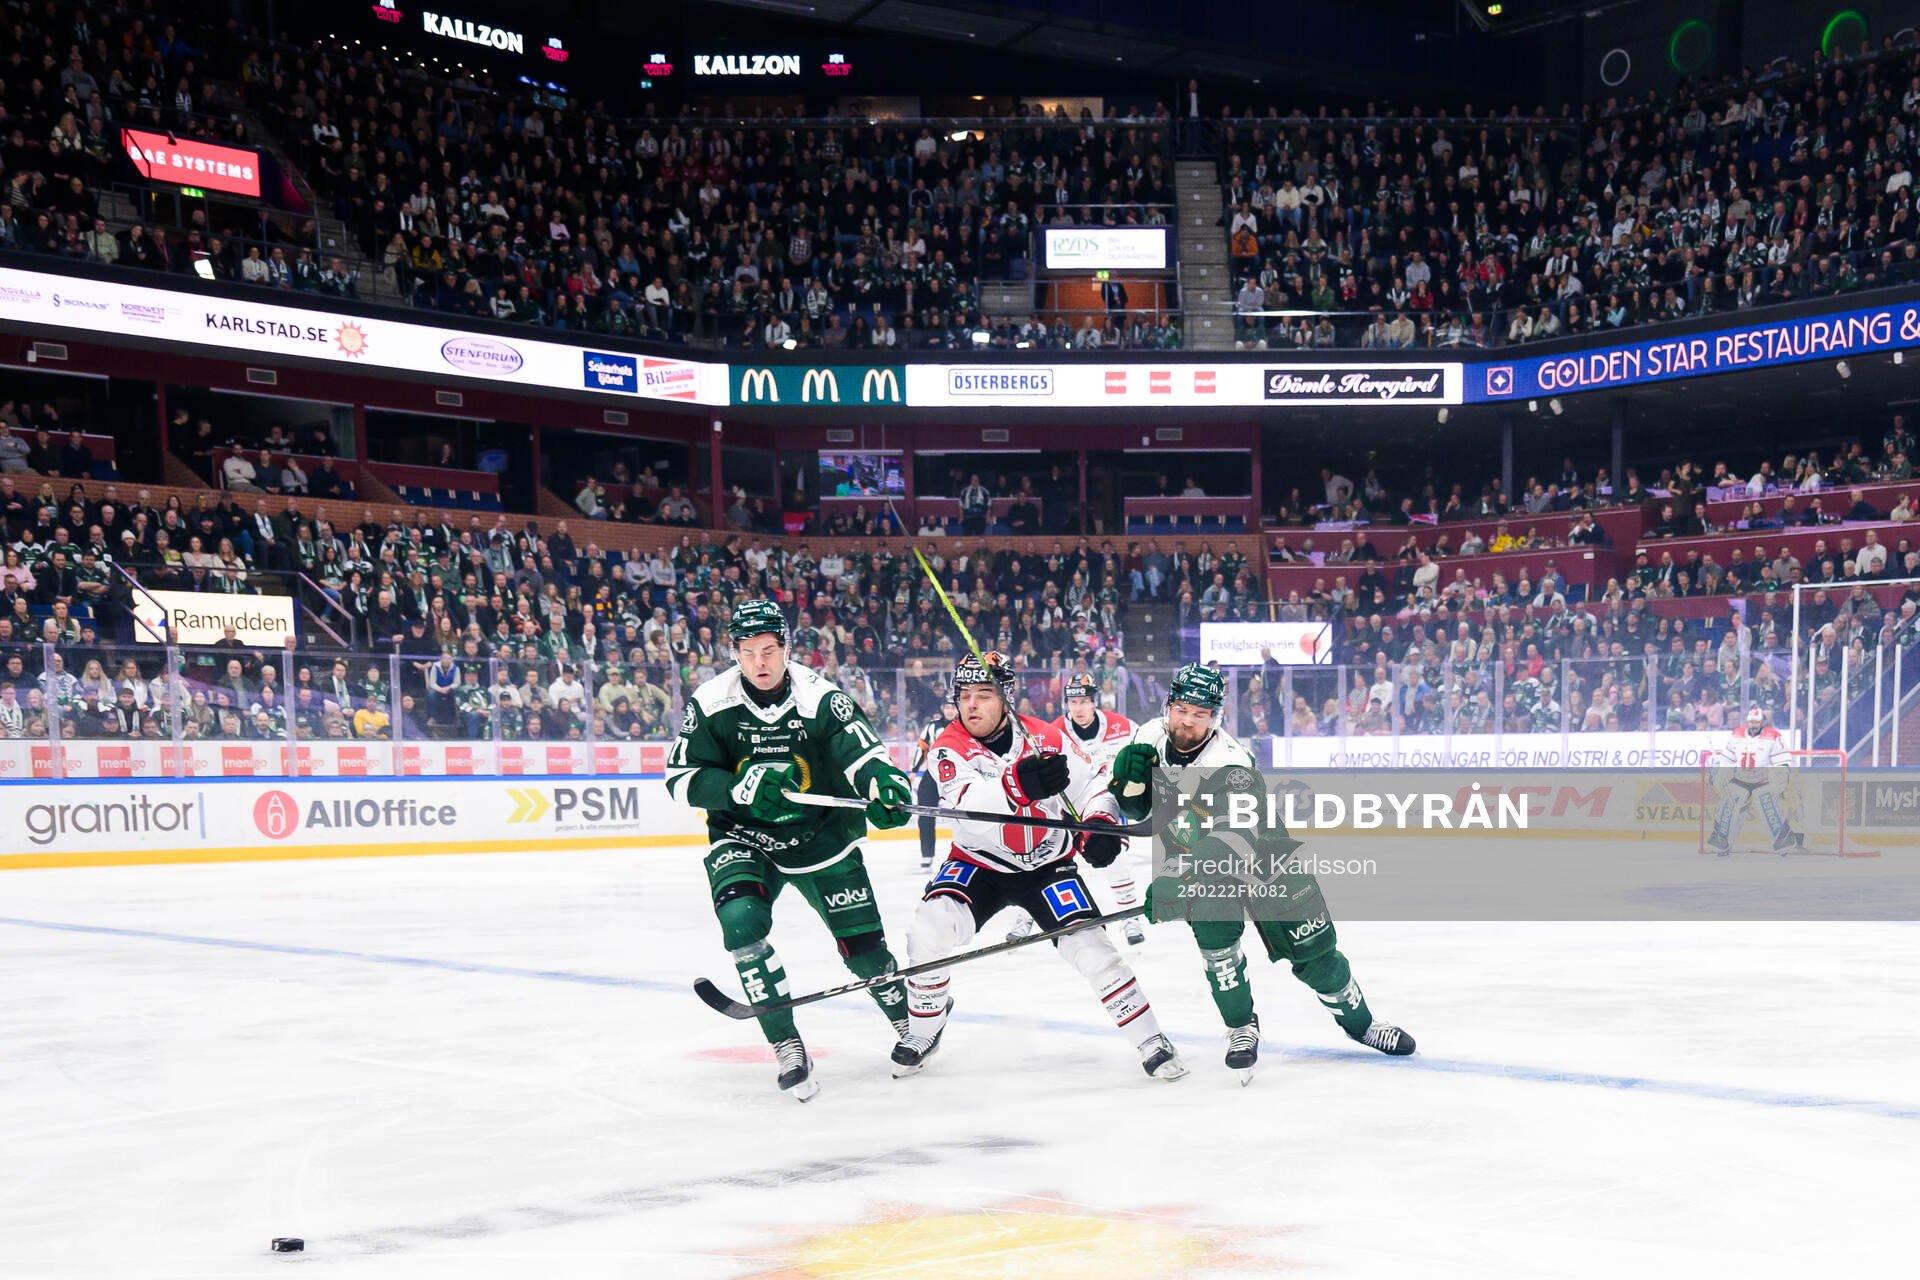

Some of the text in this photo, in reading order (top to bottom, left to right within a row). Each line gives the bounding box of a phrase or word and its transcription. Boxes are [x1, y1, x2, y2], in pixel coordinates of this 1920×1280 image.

[423, 12, 523, 54] KALLZON
[694, 55, 800, 75] KALLZON
[172, 153, 254, 181] SYSTEMS
[205, 313, 328, 343] KARLSTAD.SE
[446, 346, 518, 364] STENFORUM
[1537, 308, 1920, 391] GOLDEN STAR RESTAURANG &
[954, 371, 1049, 391] ÖSTERBERGS
[1268, 373, 1438, 400] Dömle Herrgård
[173, 608, 287, 632] Ramudden
[845, 720, 879, 750] 71
[284, 756, 325, 769] mnigo
[340, 756, 380, 769] menigo
[398, 756, 433, 769] enigo
[668, 735, 690, 766] 71
[1498, 748, 1529, 767] FÖR
[1612, 750, 1631, 767] &
[34, 756, 82, 771] meigo
[100, 756, 146, 771] menigo
[163, 756, 208, 770] mnigo
[224, 756, 268, 770] menigo
[937, 758, 957, 783] 8
[305, 798, 457, 828] AllOffice
[554, 787, 639, 821] PSM
[25, 794, 194, 845] granitor
[824, 888, 868, 908] voky
[1289, 913, 1326, 940] voky
